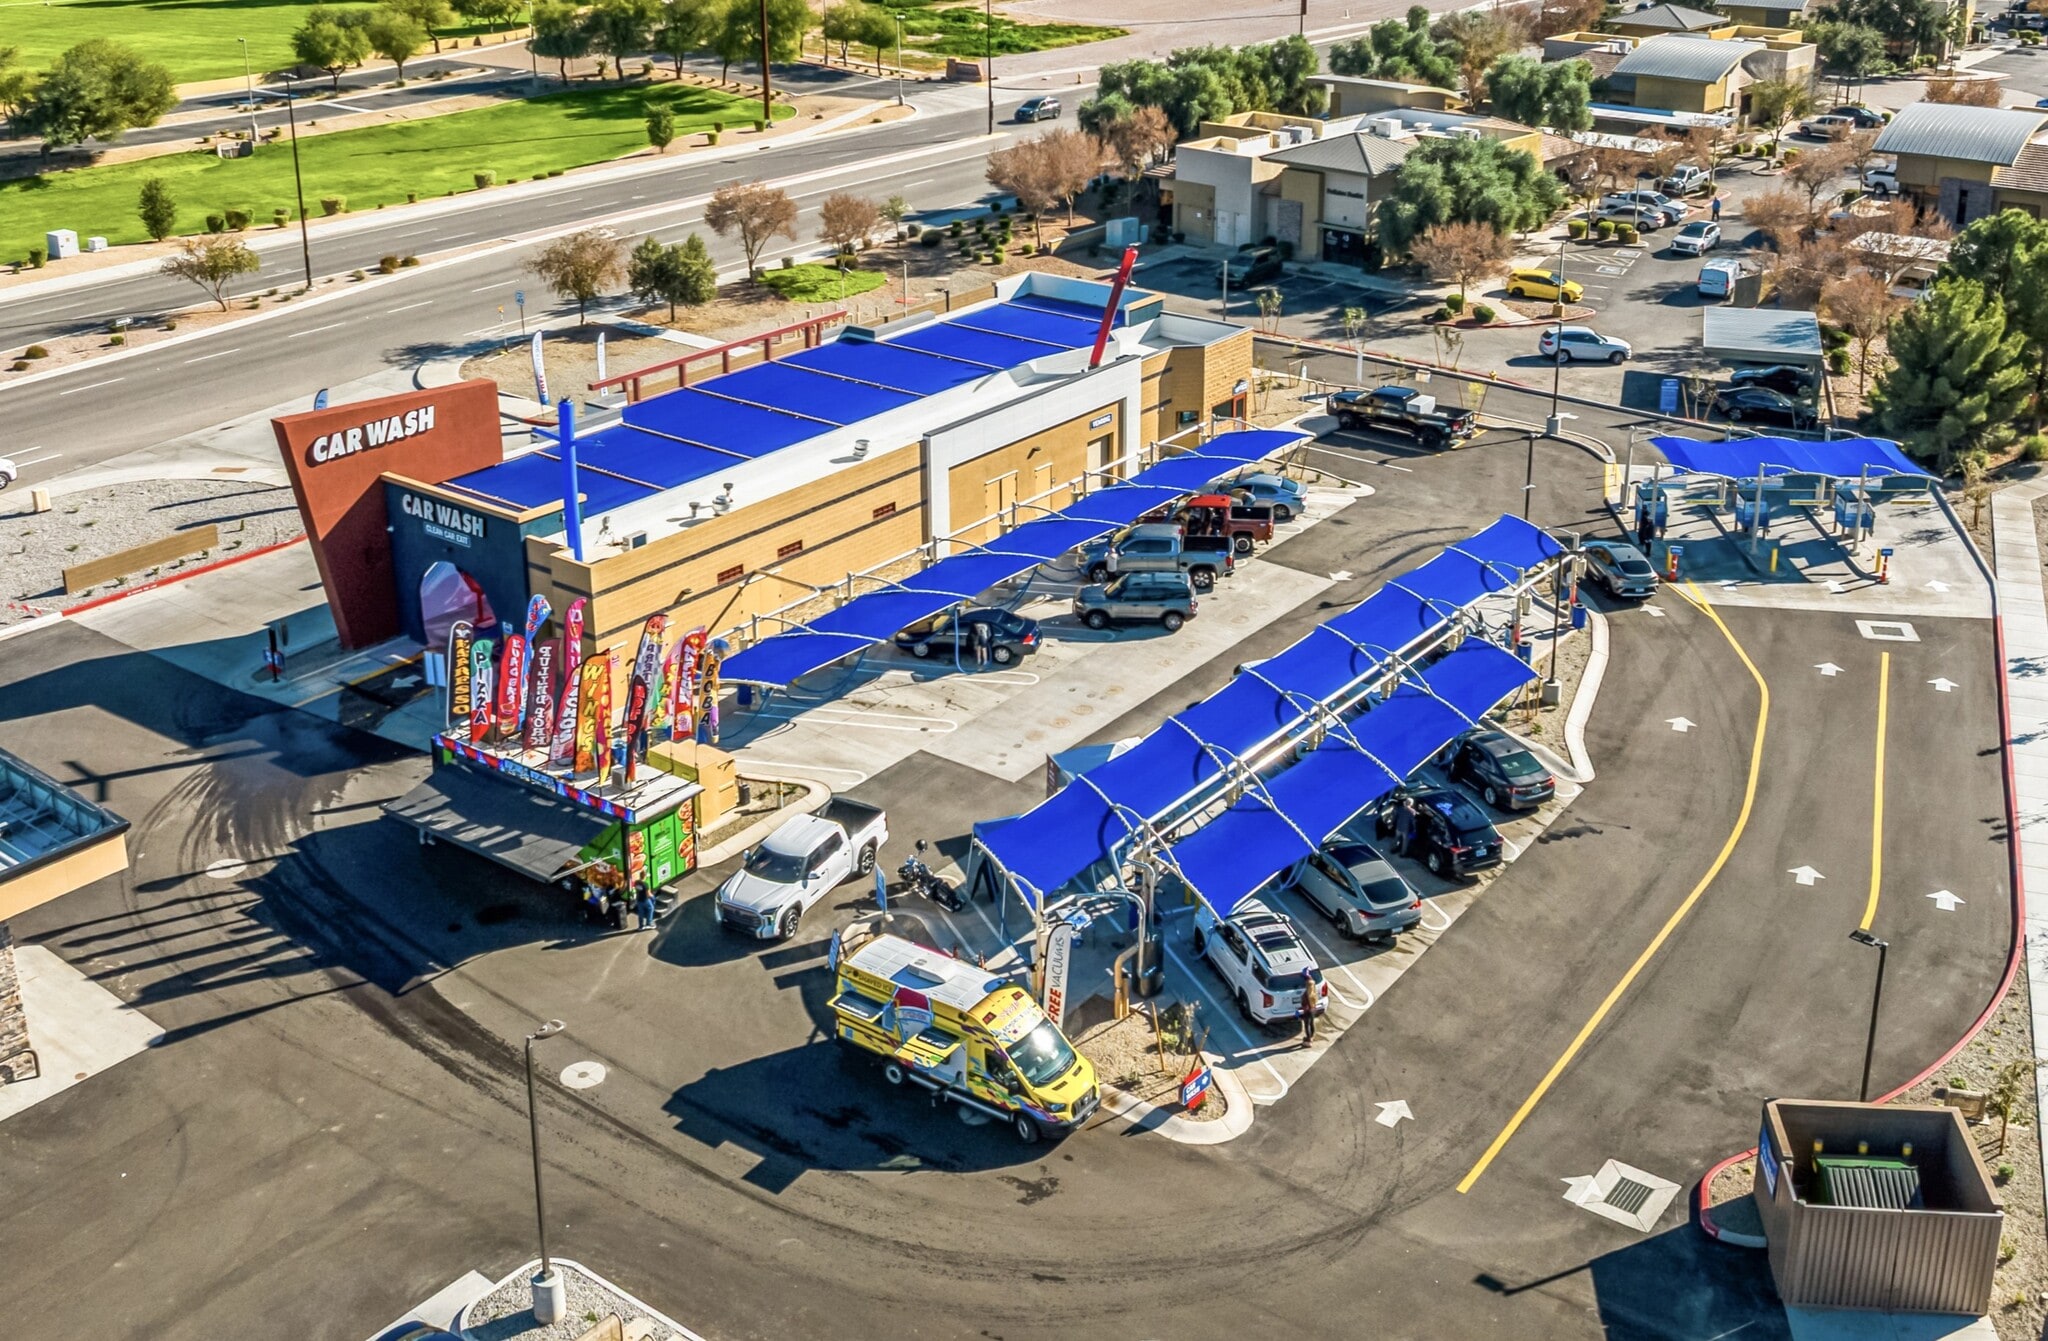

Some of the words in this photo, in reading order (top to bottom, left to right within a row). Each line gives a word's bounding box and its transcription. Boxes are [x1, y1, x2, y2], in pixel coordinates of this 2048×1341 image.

[312, 427, 363, 463] CAR
[366, 405, 436, 448] WASH
[402, 493, 434, 522] CAR
[435, 503, 485, 538] WASH
[425, 524, 443, 537] CLEAN
[444, 530, 455, 541] CAR
[473, 650, 489, 726] PIZZA
[583, 664, 605, 753] WINGS
[700, 662, 716, 725] BOBA
[1051, 936, 1065, 989] VACUUMS
[1047, 987, 1062, 1025] FREE
